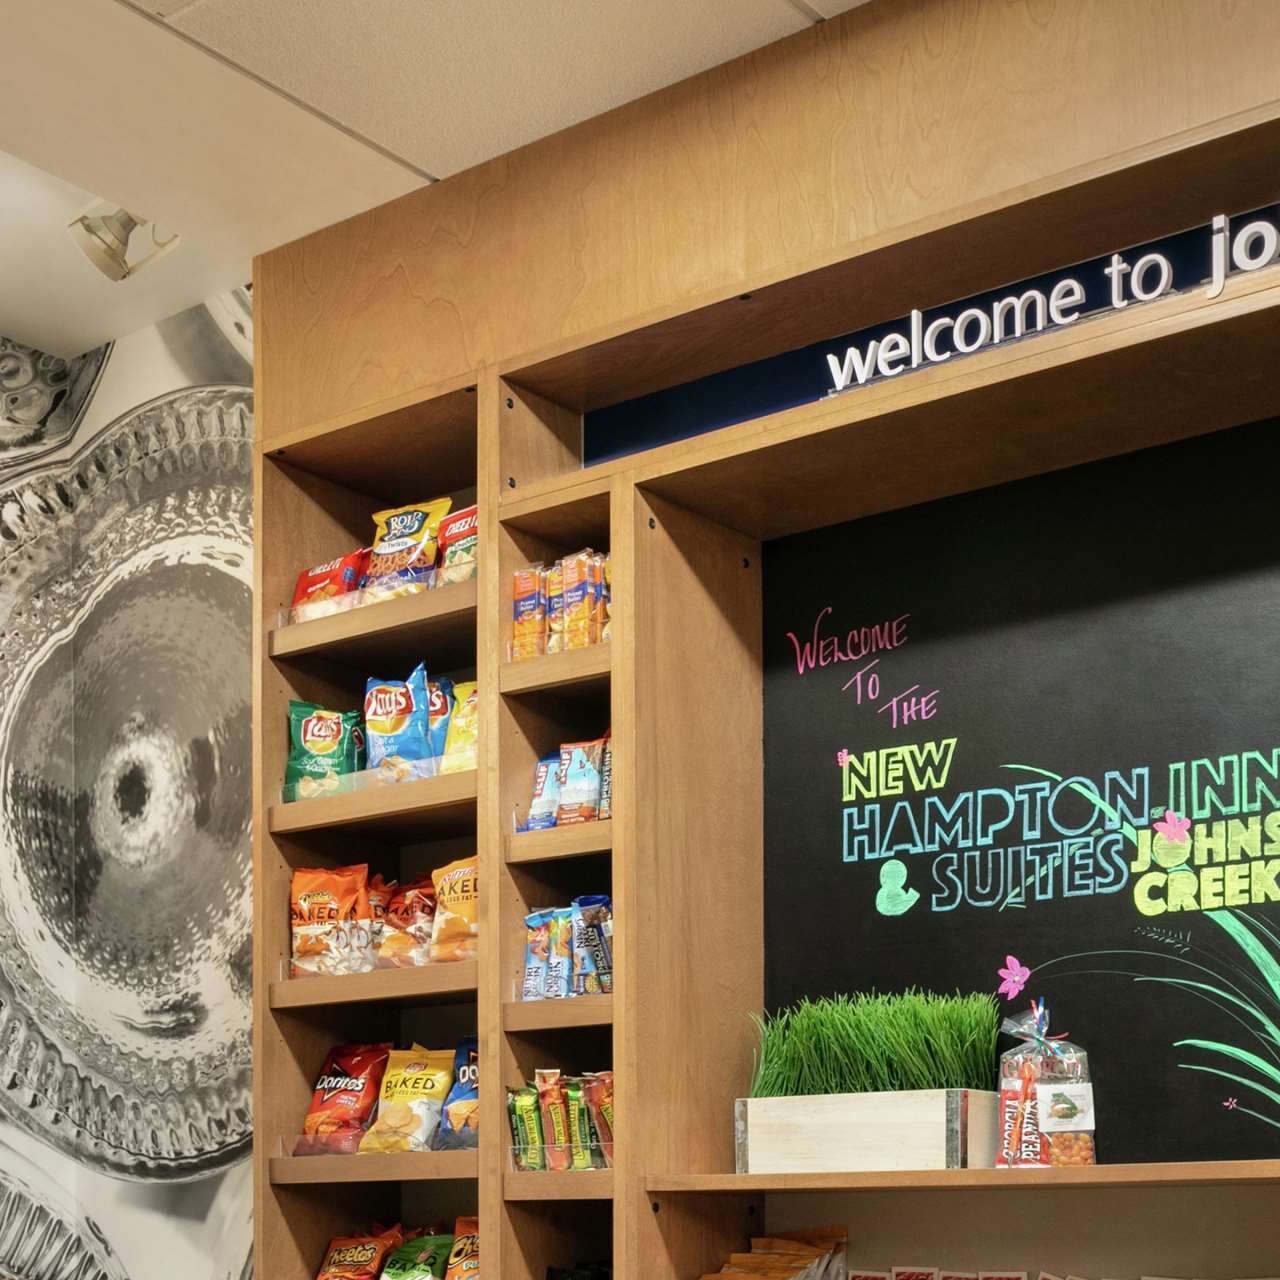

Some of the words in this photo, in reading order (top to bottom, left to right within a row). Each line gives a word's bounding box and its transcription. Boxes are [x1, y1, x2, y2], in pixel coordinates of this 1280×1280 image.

[826, 277, 1086, 392] welcome
[1105, 251, 1173, 310] to
[842, 660, 881, 704] TO
[878, 685, 940, 728] THE
[841, 737, 958, 801] NEW
[842, 767, 1150, 862] HAMPTON
[931, 833, 1128, 912] SUITES
